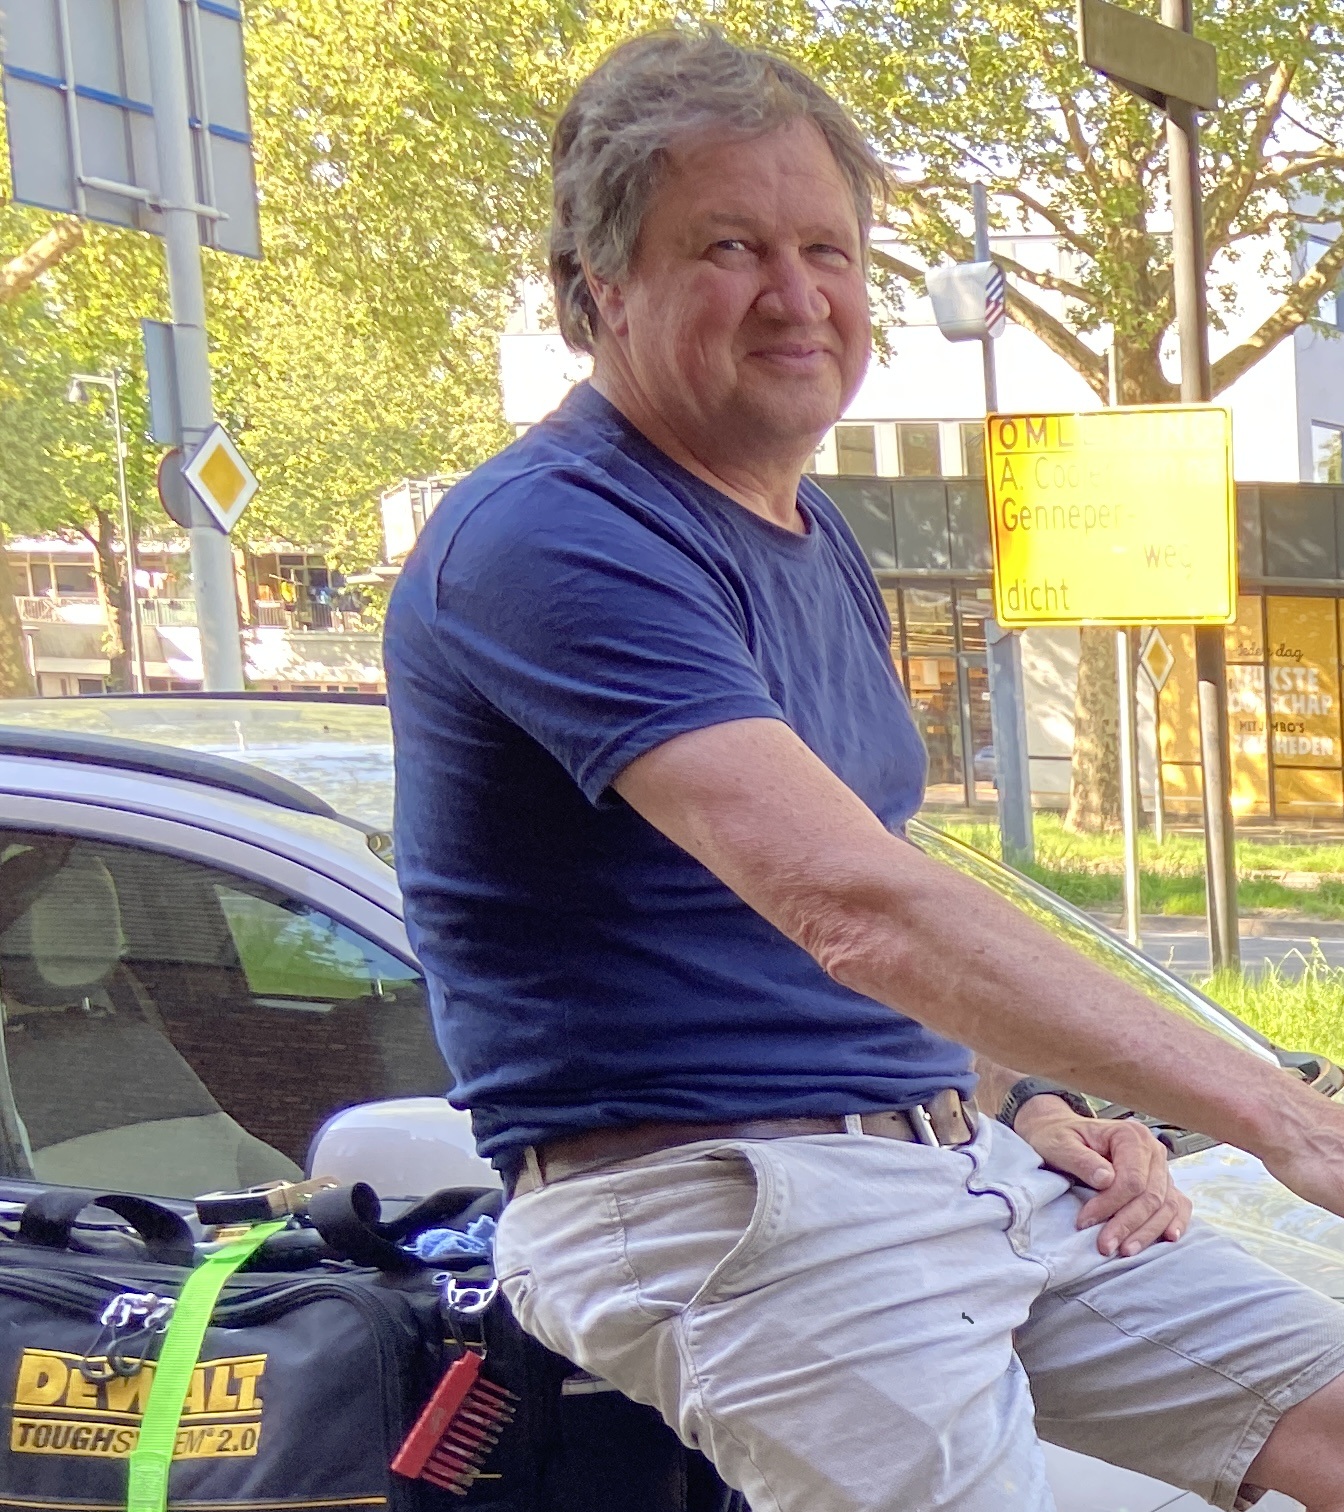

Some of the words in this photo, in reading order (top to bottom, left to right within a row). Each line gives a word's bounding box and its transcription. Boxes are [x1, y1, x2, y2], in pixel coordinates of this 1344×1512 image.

[1007, 579, 1070, 612] dicht
[1276, 643, 1304, 662] dag
[216, 1427, 257, 1452] 2.0
